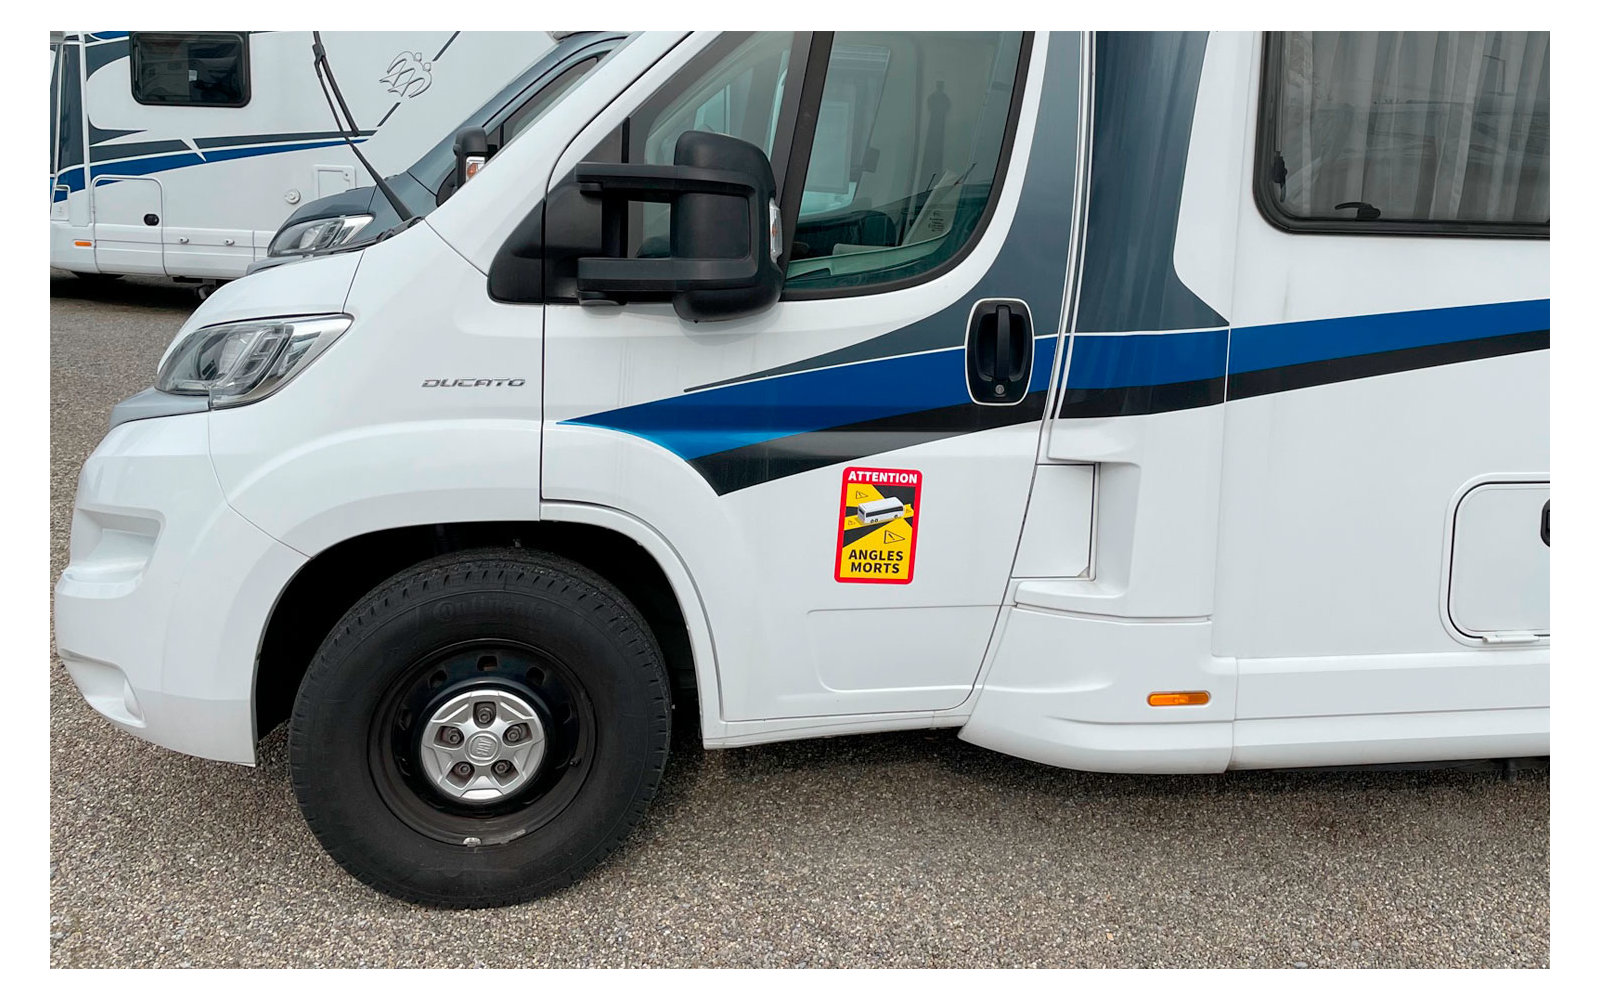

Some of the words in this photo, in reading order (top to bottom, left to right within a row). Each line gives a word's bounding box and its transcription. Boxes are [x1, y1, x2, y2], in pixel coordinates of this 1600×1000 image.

[421, 378, 526, 388] DUCATO
[848, 470, 918, 484] ATTENTION
[848, 549, 904, 562] ANGLES
[850, 561, 900, 574] MORTS
